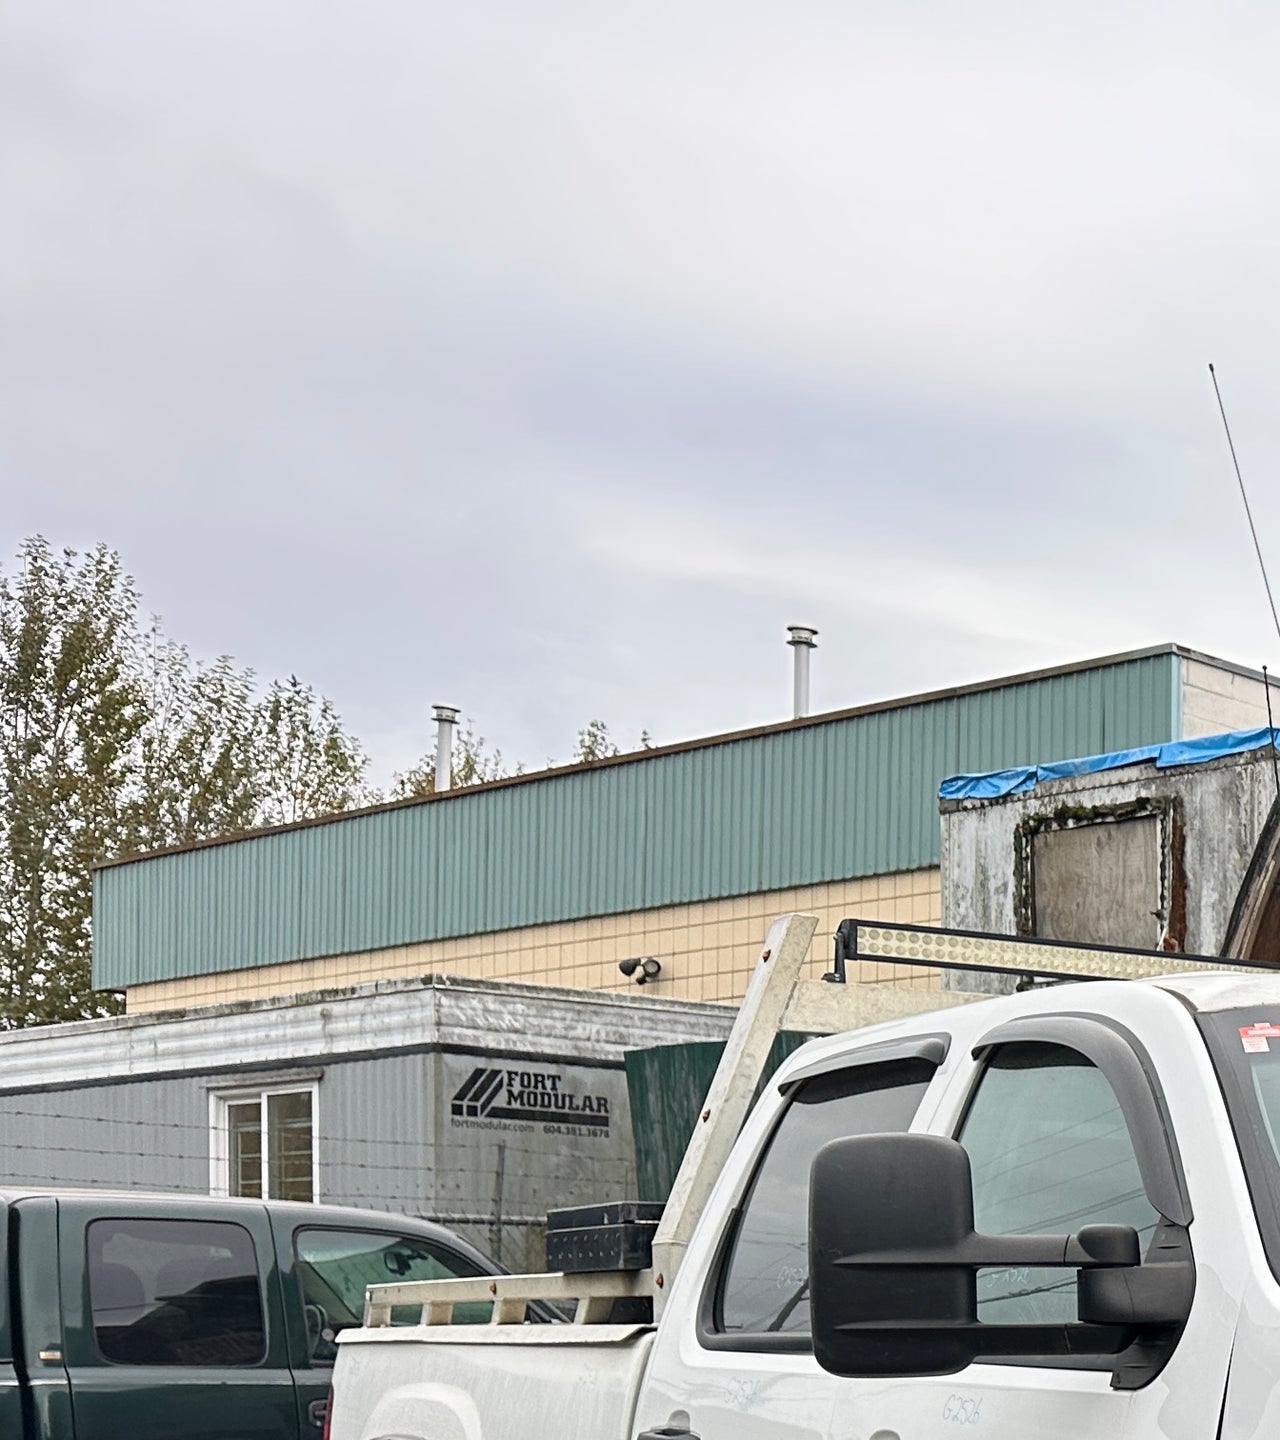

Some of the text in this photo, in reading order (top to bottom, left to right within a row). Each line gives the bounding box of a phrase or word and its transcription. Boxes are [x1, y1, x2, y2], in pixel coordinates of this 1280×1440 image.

[506, 1070, 562, 1091] FORT
[506, 1089, 609, 1114] MODULAR
[451, 1117, 535, 1133] fortmodular.com
